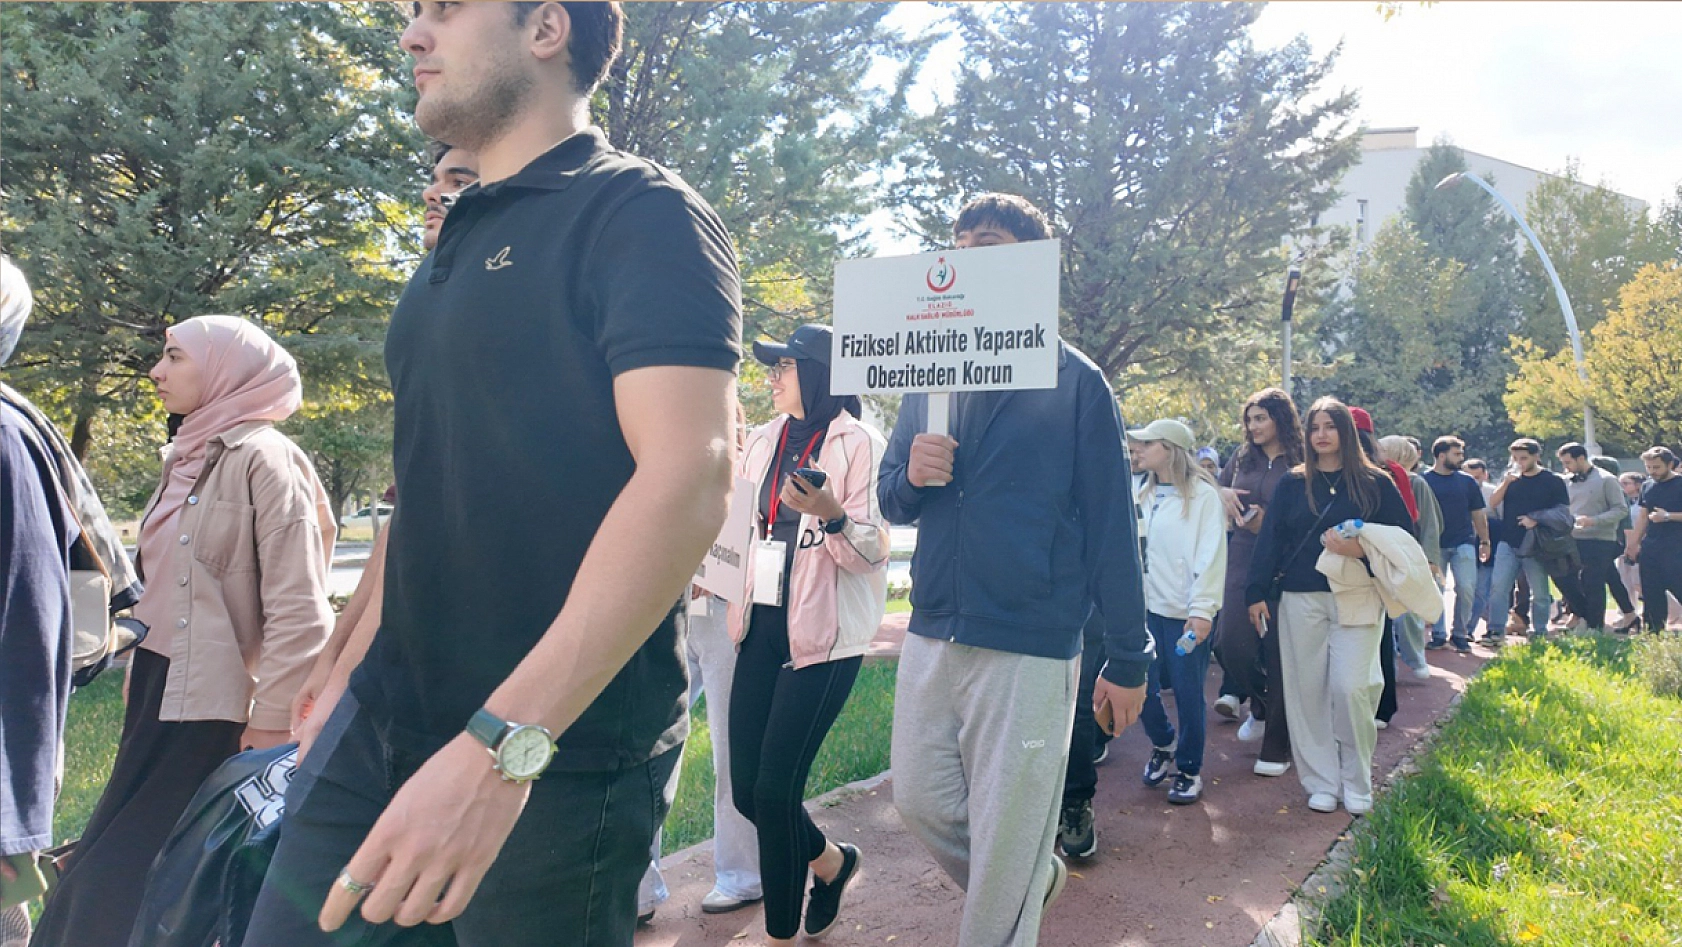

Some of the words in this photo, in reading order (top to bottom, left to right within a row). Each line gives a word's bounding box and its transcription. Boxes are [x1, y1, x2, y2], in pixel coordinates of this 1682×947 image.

[841, 332, 900, 358] Fiziksel
[904, 328, 968, 355] Aktivite
[974, 323, 1046, 356] Yaparak
[866, 362, 957, 389] Obeziteden
[962, 360, 1013, 385] Korun
